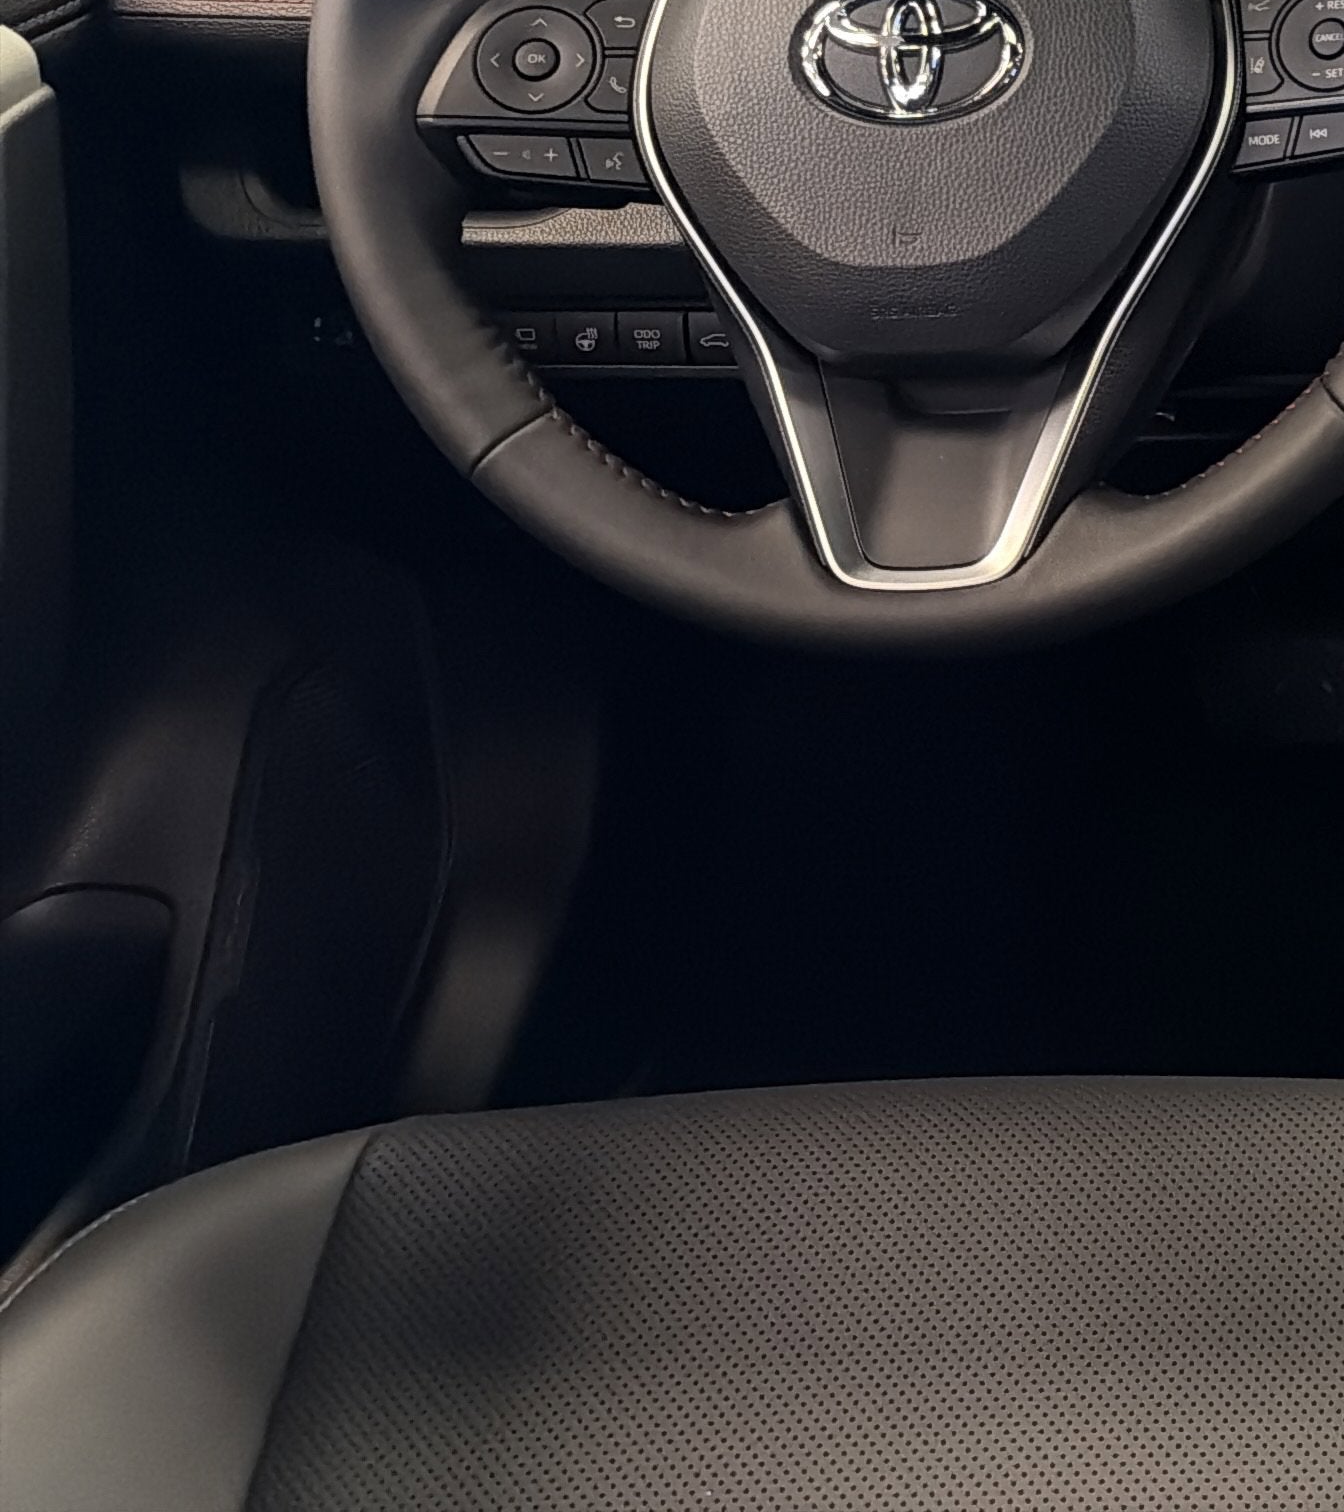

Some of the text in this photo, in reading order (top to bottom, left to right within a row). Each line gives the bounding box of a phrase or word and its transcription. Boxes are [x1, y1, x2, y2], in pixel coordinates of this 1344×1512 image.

[1315, 33, 1344, 42] CANCEL
[527, 54, 546, 64] OK
[1325, 68, 1344, 78] SET
[1248, 134, 1281, 146] MODE
[633, 329, 661, 339] ODO
[635, 340, 661, 350] TRIP
